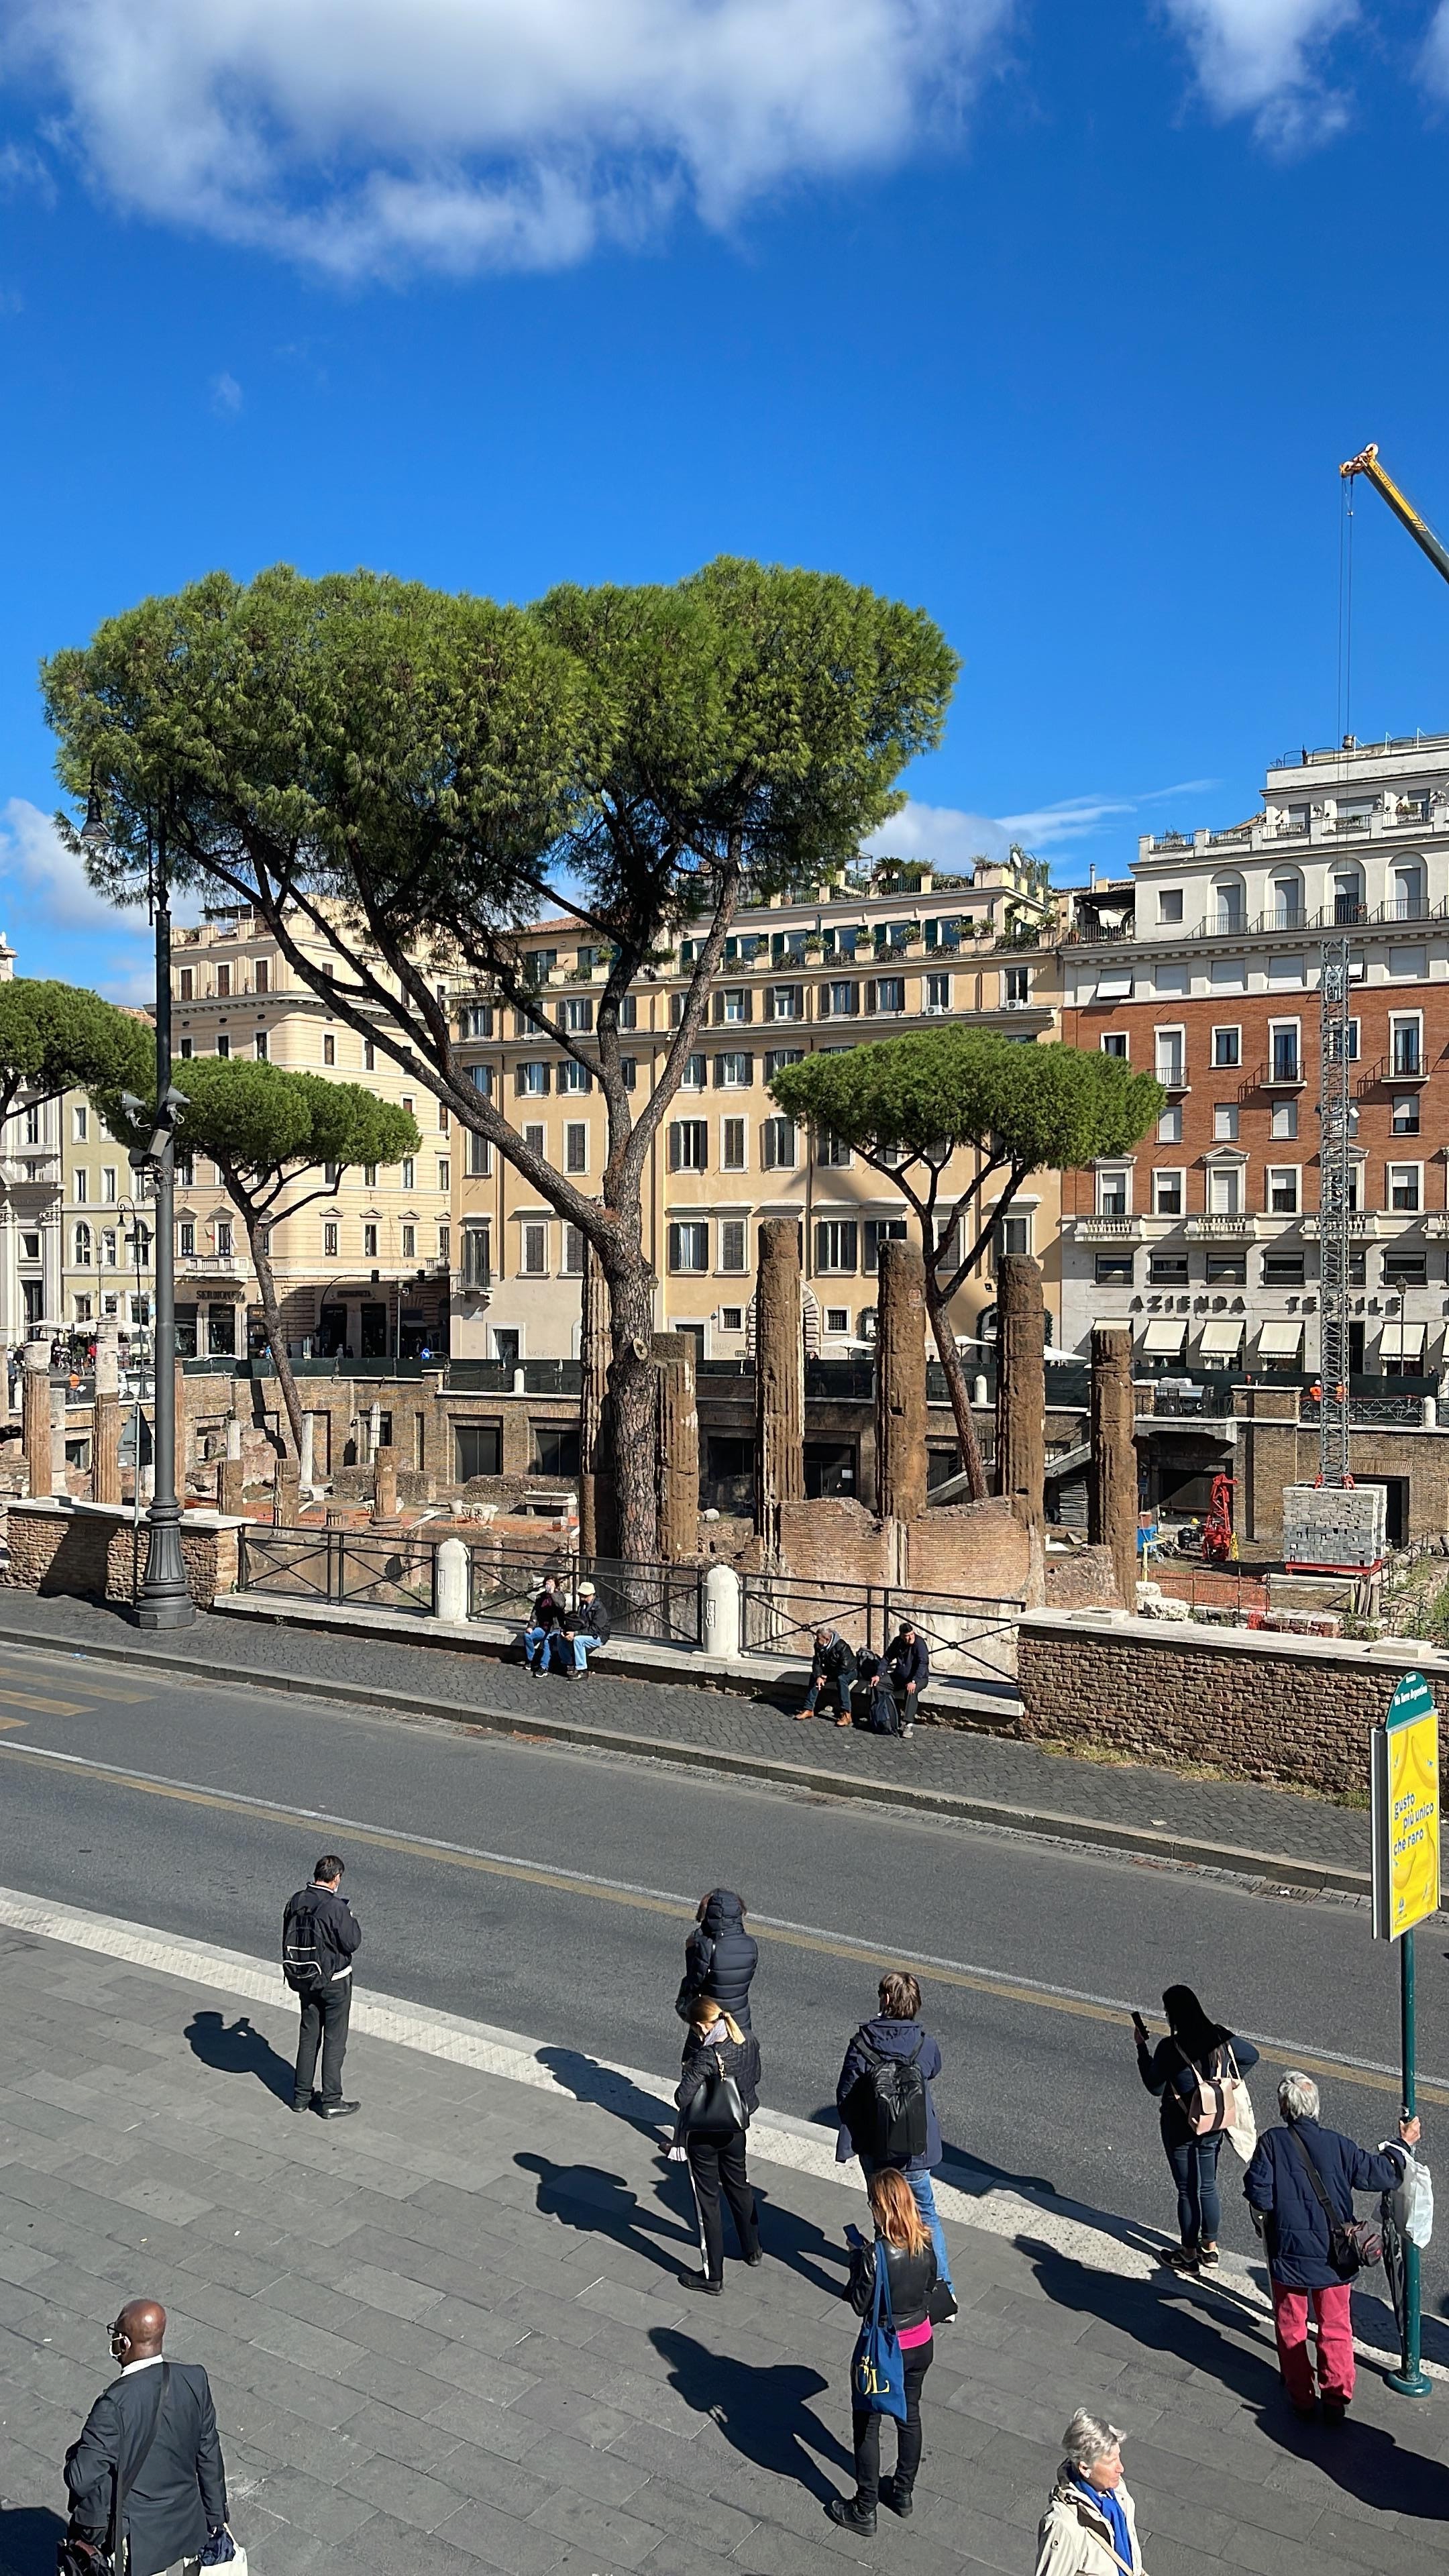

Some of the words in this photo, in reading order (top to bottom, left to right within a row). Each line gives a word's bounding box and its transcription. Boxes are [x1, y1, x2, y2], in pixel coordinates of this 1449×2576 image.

[1128, 1295, 1246, 1314] AZIENDA
[1285, 1297, 1401, 1316] TESILE
[1395, 1791, 1415, 1821] gusto
[1403, 1809, 1413, 1836] più
[1415, 1801, 1434, 1822] unico
[1394, 1837, 1406, 1856] che
[1407, 1829, 1424, 1848] raro
